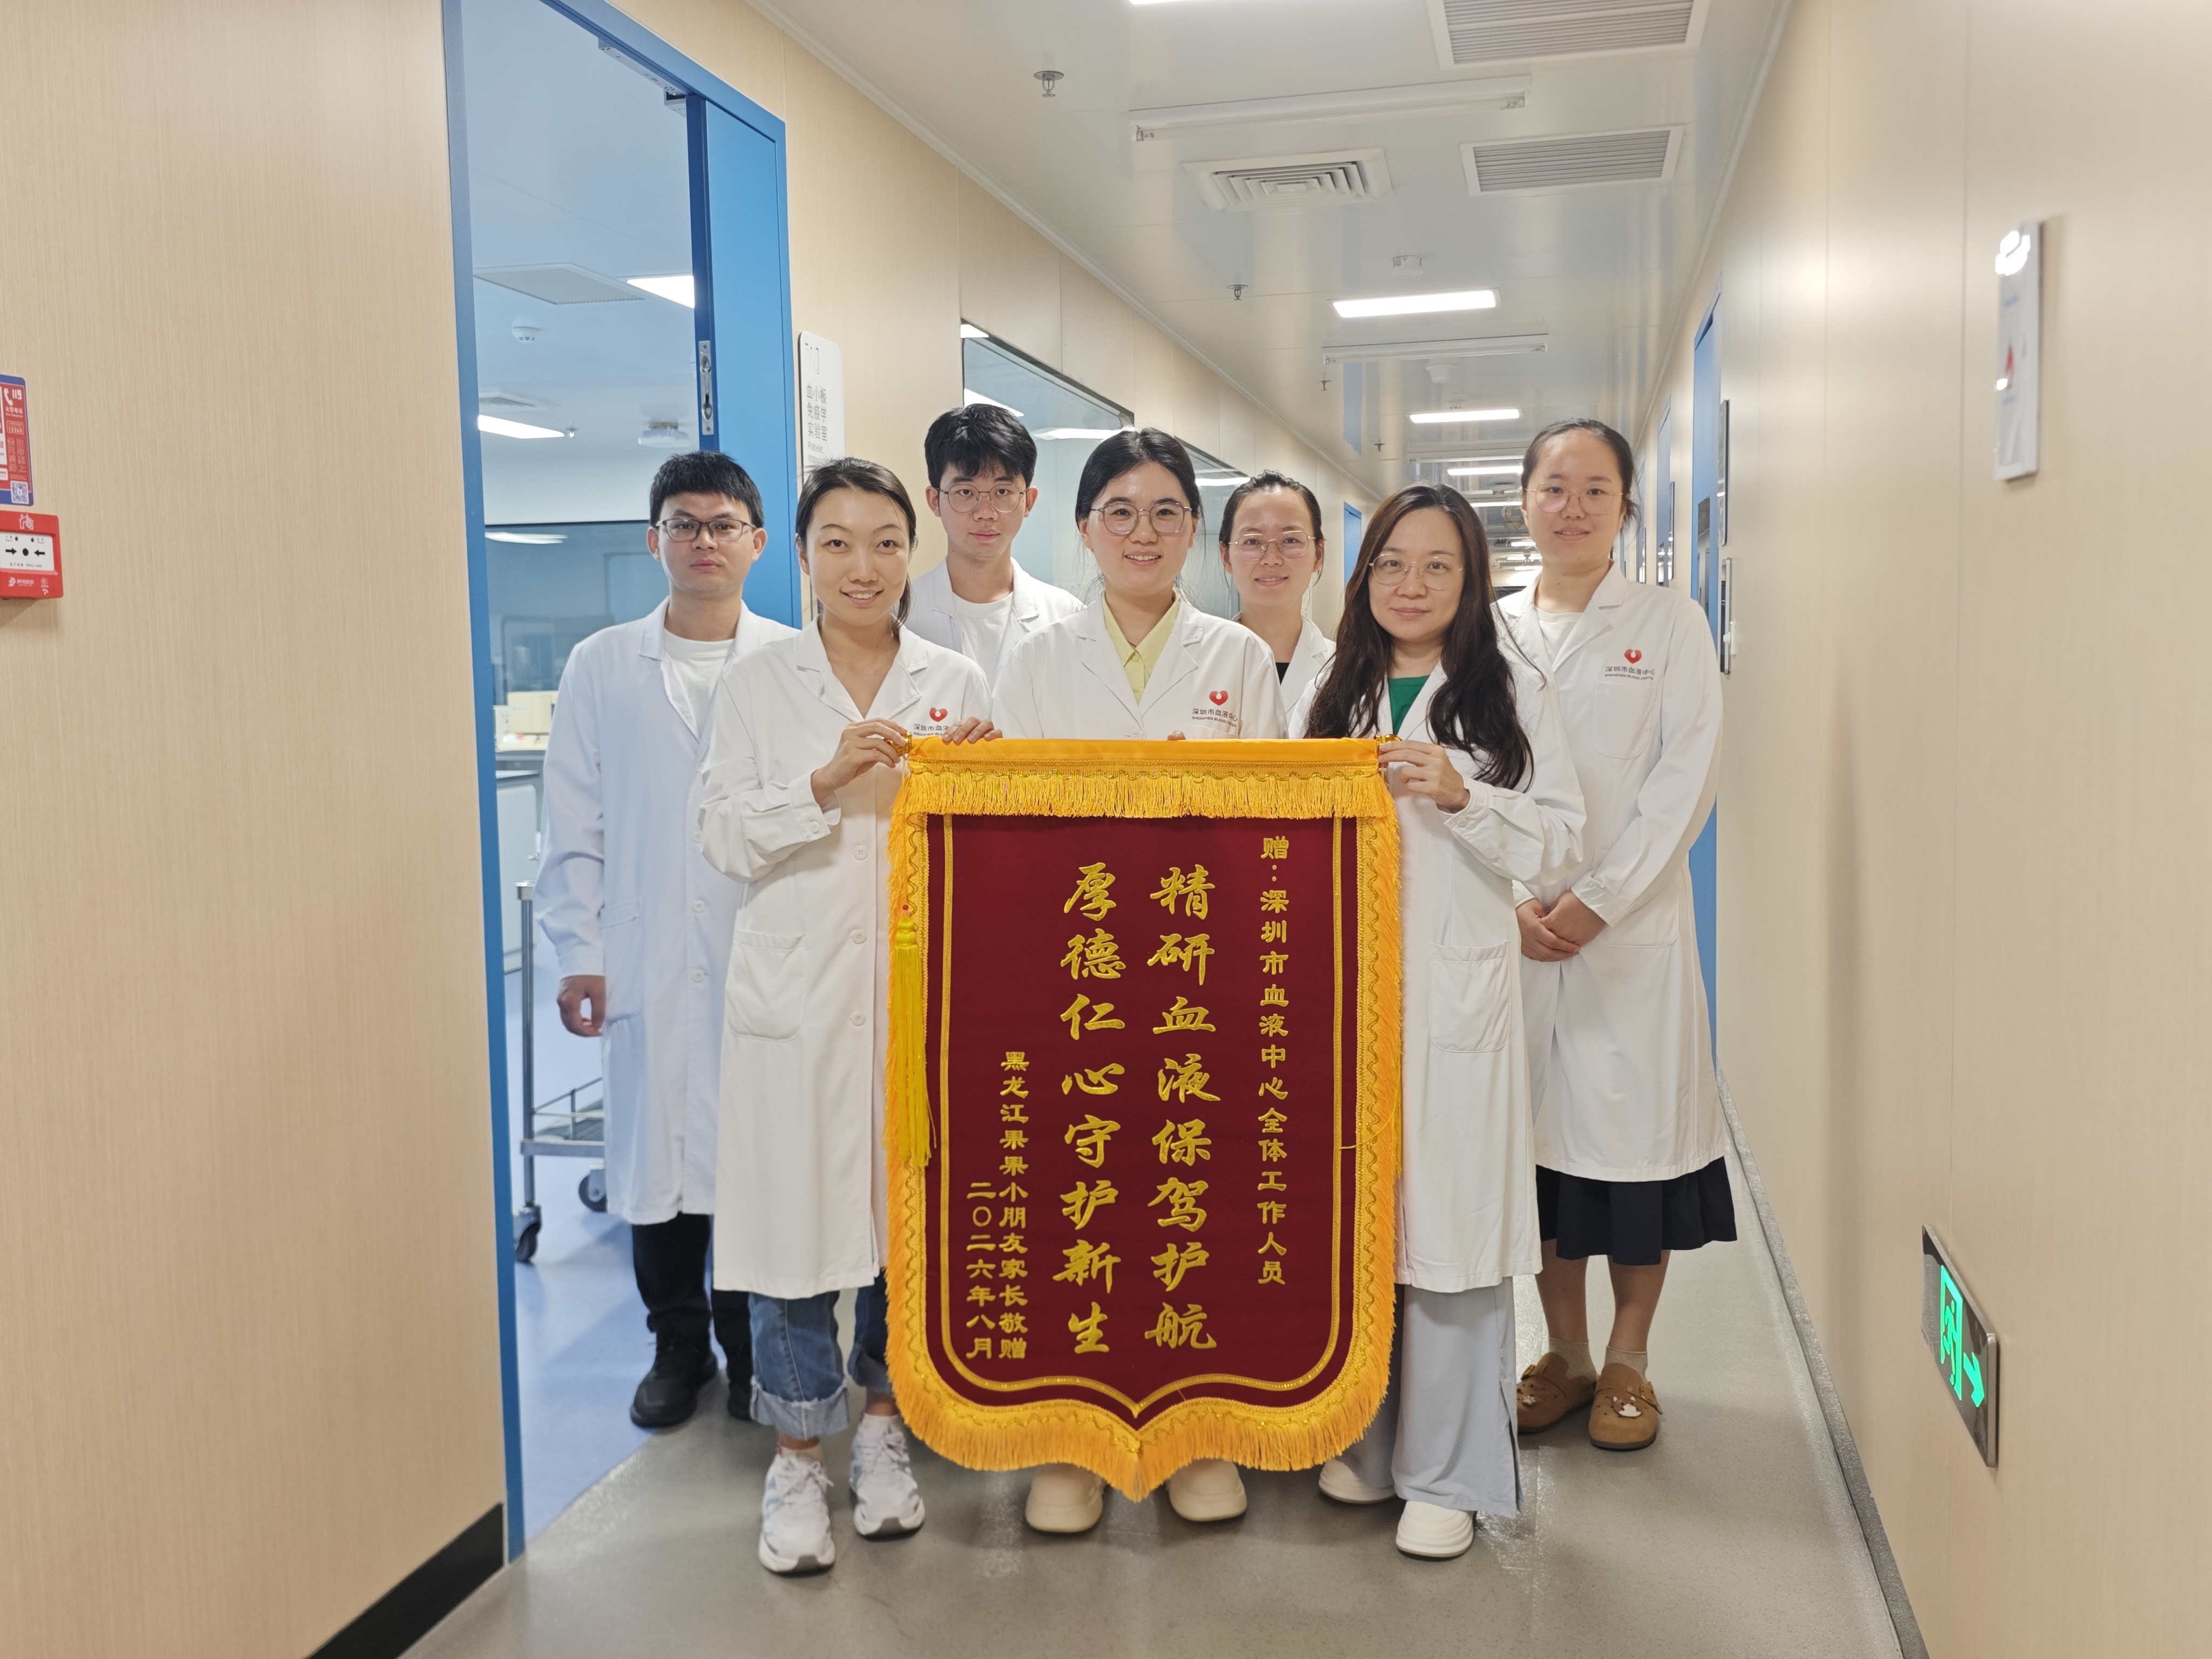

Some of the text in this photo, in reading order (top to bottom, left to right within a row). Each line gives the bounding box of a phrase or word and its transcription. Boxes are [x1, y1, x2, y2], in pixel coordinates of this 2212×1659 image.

[12, 389, 22, 400] 119
[807, 383, 827, 404] 血小板
[807, 402, 827, 423] 免疫学
[808, 421, 828, 442] 实验室
[1605, 666, 1655, 675] 深圳市血液中心
[1192, 708, 1238, 721] 深圳市血液中心
[1052, 862, 1127, 1353] 厚德仁心守护新生
[1144, 864, 1221, 1349] 精研血液保驾护航
[999, 1051, 1030, 1359] 黑龙江果果小朋友家长敬赠
